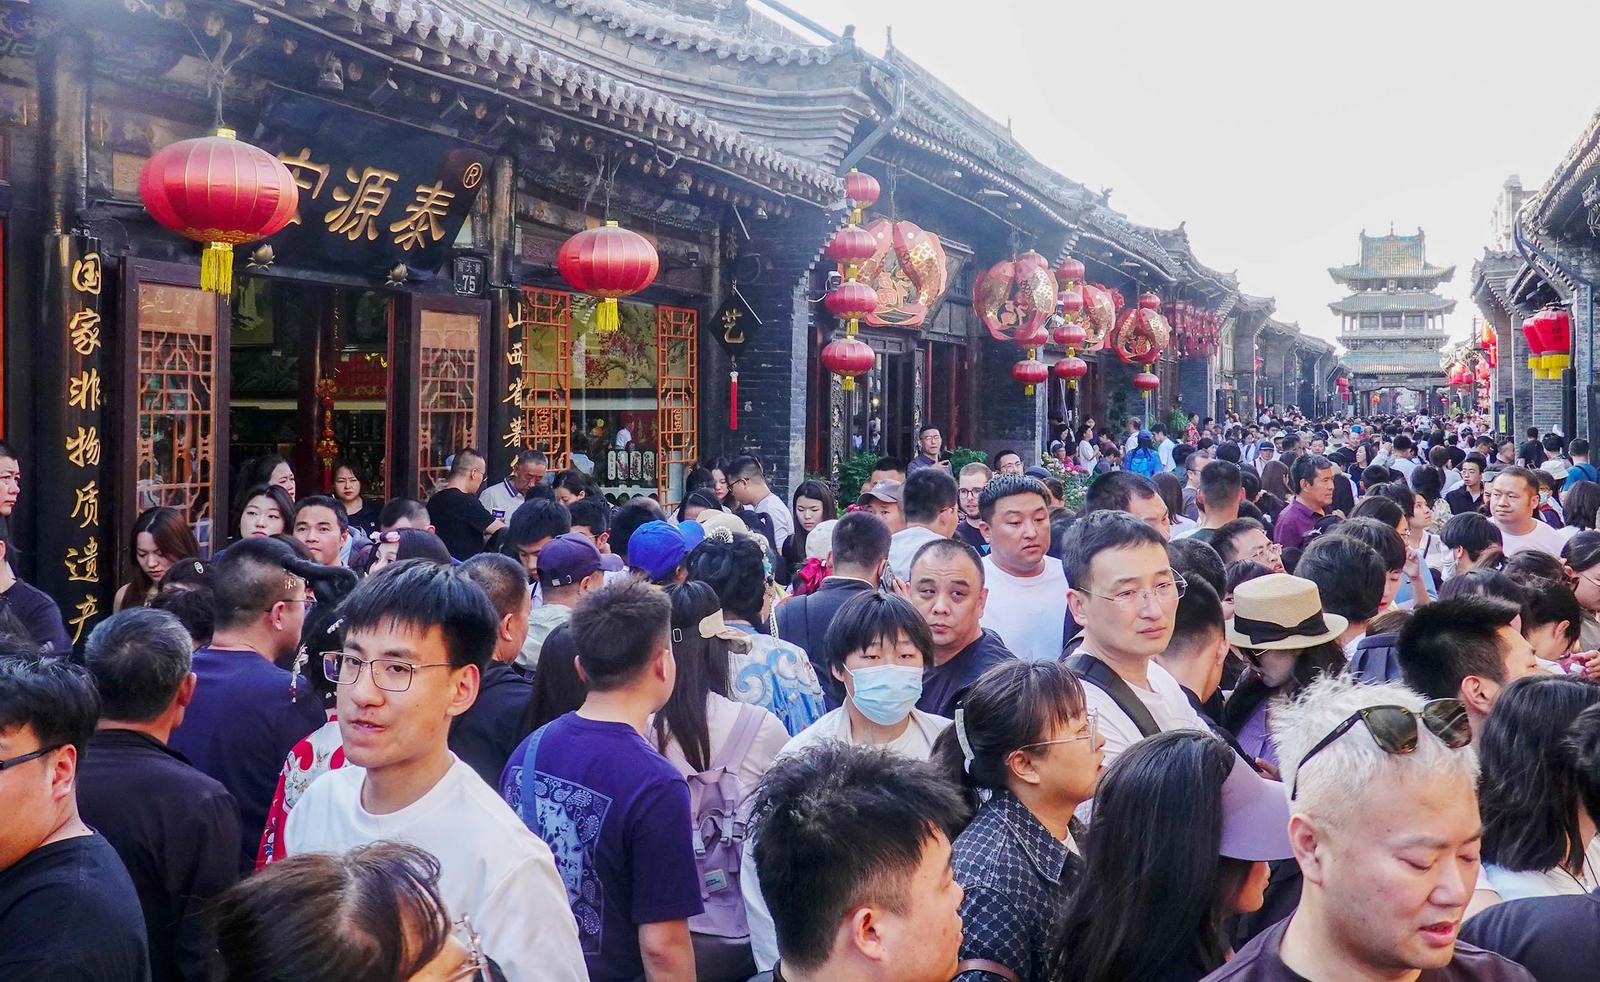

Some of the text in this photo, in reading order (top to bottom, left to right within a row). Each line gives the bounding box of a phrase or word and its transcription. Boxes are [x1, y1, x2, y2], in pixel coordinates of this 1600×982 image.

[462, 274, 476, 292] 75
[721, 307, 744, 343] 艺
[502, 302, 523, 475] 山西省著
[65, 252, 101, 646] 国家非物质遗产
